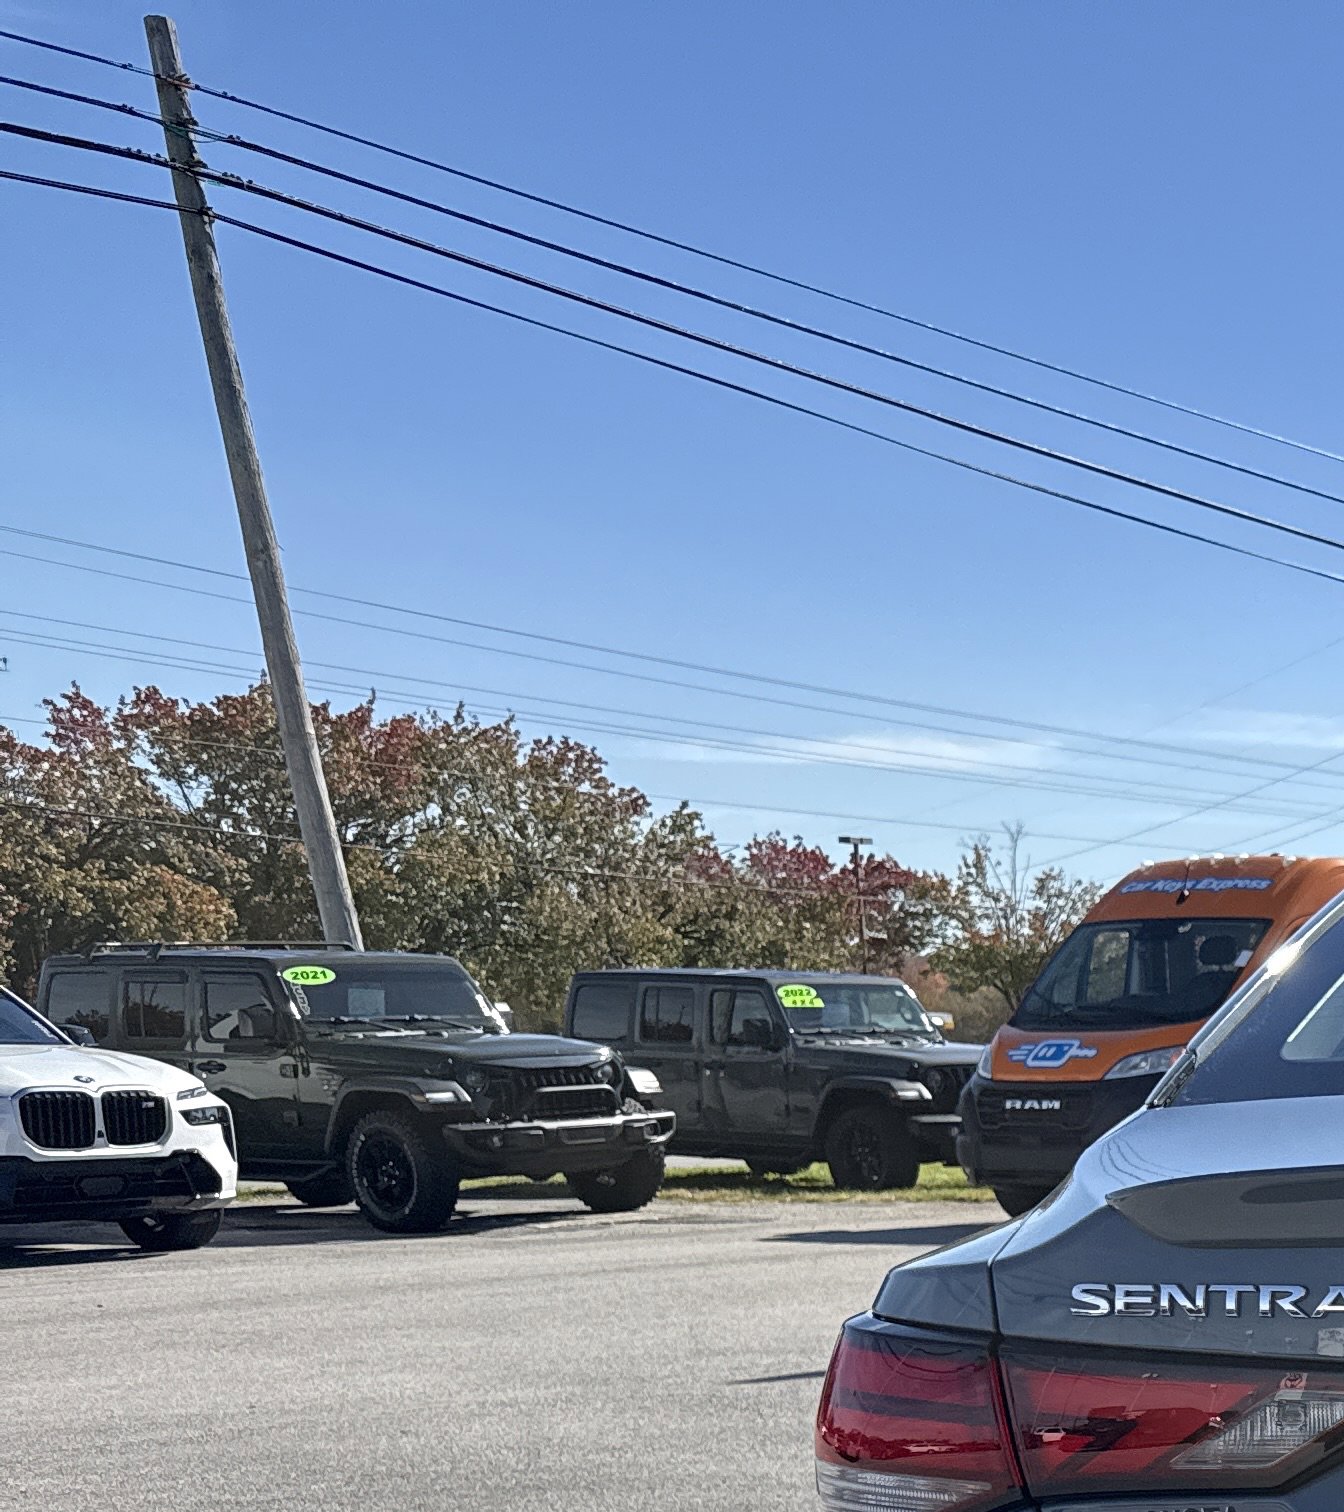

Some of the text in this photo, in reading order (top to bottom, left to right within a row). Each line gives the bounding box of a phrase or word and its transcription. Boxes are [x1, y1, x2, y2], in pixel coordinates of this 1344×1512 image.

[1121, 881, 1150, 894] Car
[1197, 877, 1274, 892] Express
[290, 970, 327, 980] 2021
[783, 988, 812, 998] 2022
[1005, 1099, 1061, 1110] RAM
